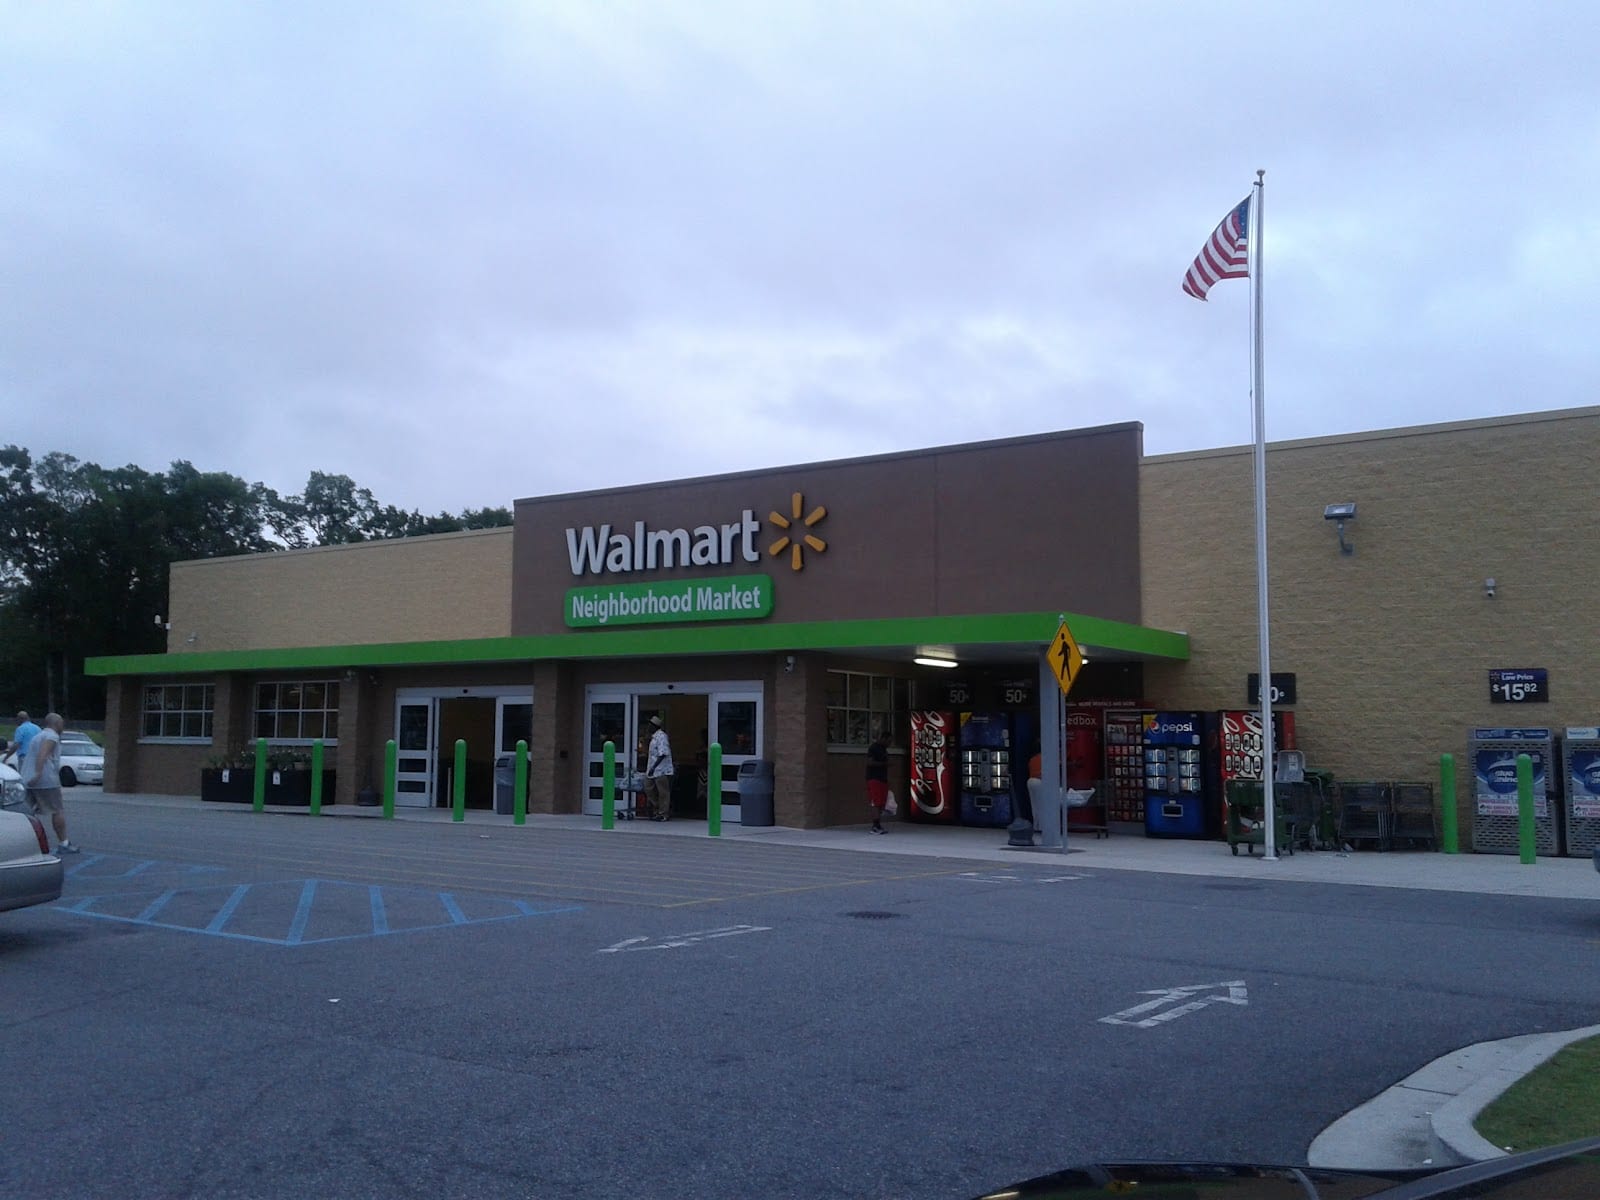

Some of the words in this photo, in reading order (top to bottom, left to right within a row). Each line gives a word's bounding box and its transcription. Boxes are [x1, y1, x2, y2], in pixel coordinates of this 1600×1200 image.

[565, 509, 760, 576] Walmart
[572, 587, 693, 623] Neighborhood
[696, 584, 761, 611] Market
[1066, 716, 1097, 726] edbox
[1161, 722, 1193, 734] pepsi
